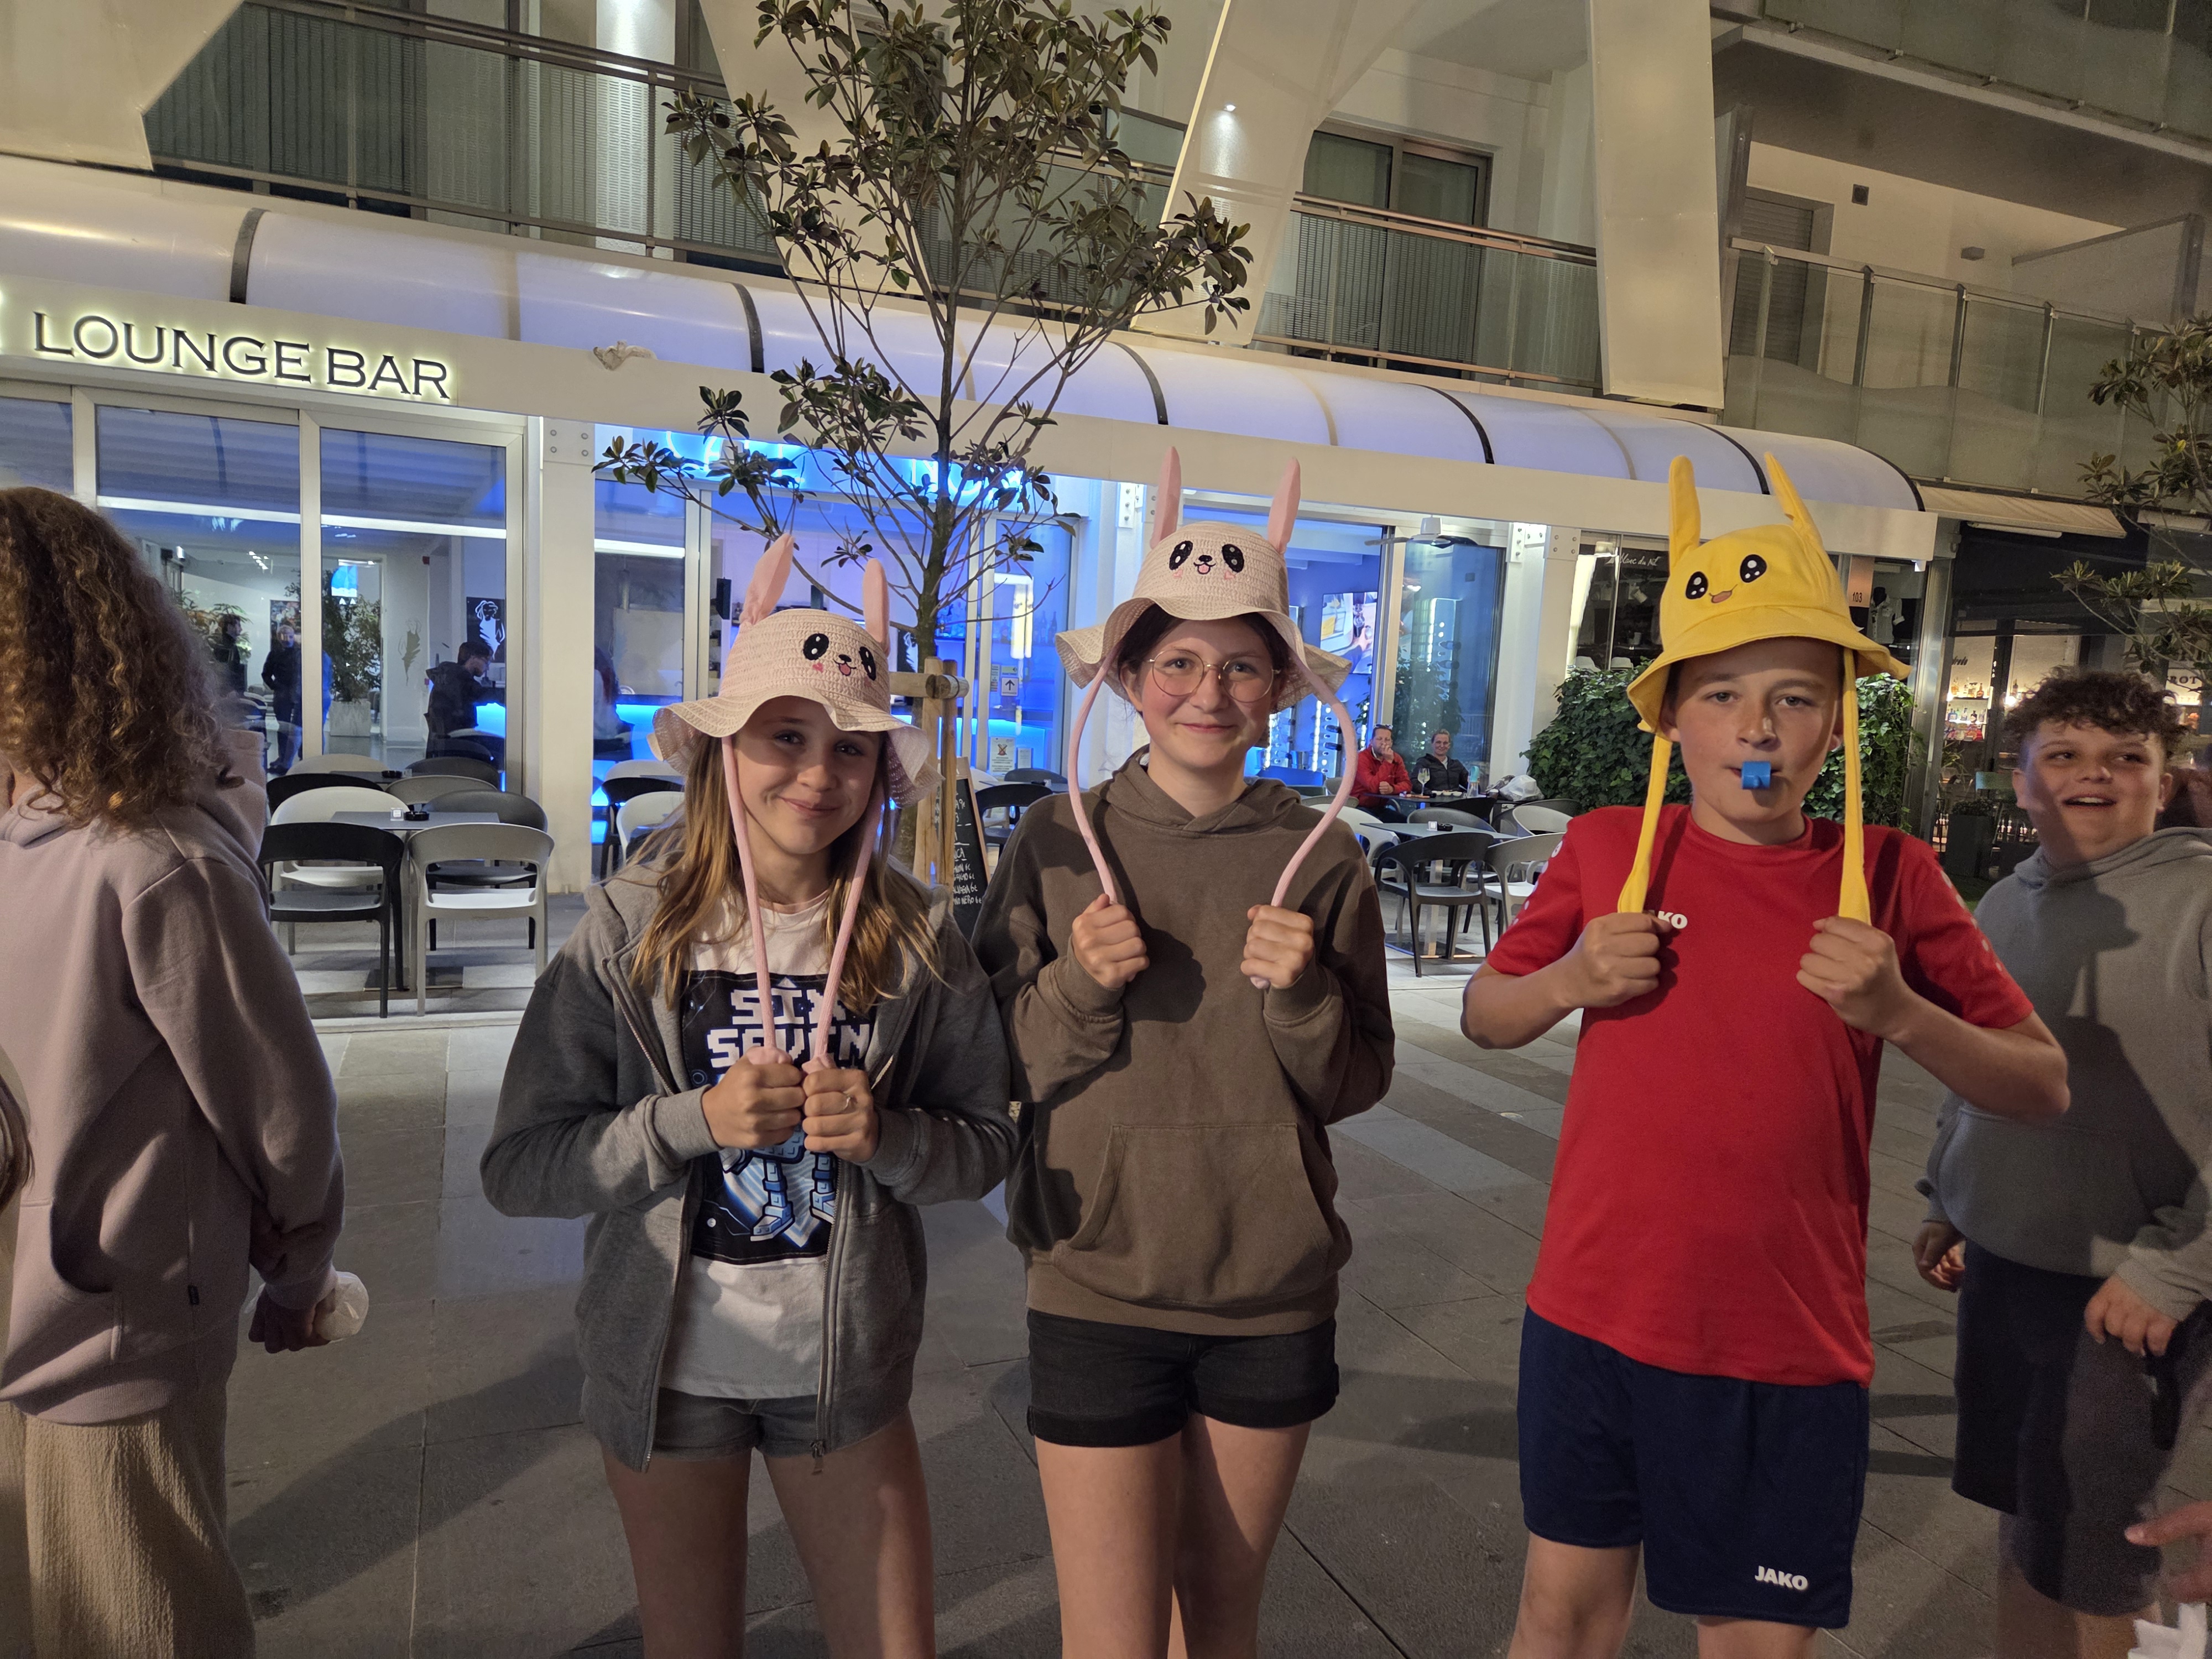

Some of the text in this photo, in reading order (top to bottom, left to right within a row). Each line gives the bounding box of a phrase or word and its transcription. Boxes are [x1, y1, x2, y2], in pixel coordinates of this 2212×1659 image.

[33, 311, 450, 399] LOUNGE BAR
[1853, 592, 1863, 603] 103
[1648, 910, 1688, 928] KO
[1755, 1566, 1808, 1590] JAKO
